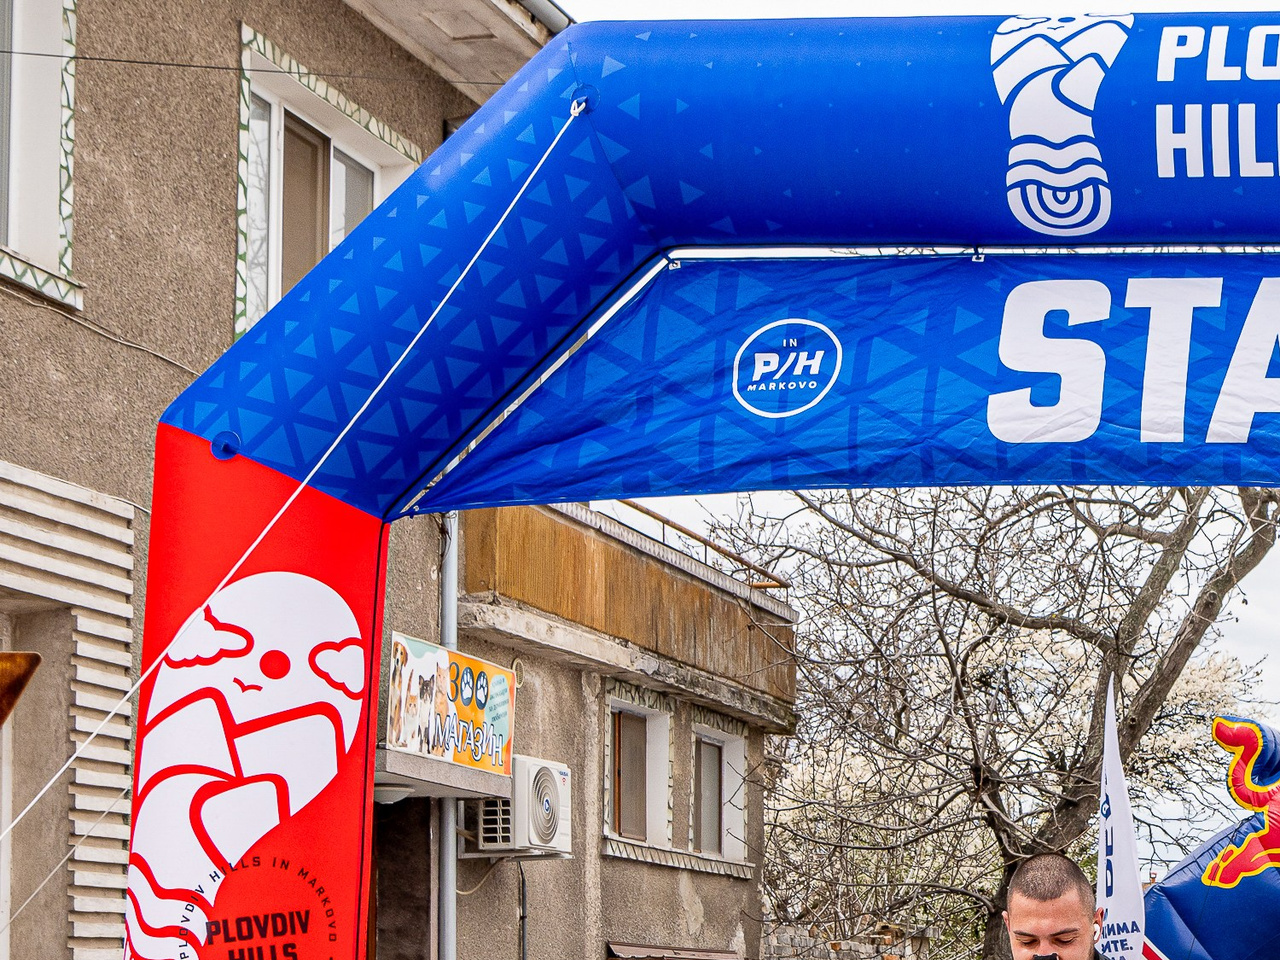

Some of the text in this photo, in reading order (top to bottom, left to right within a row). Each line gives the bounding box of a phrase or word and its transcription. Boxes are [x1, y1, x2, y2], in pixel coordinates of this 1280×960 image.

[783, 338, 797, 347] IN
[752, 350, 825, 382] P/H
[747, 381, 817, 391] MARKOVO
[434, 712, 504, 767] МАГАЗИН
[178, 856, 337, 960] PLOVDIV HILLS IN MARKOVO
[205, 909, 310, 945] PLOVDIV
